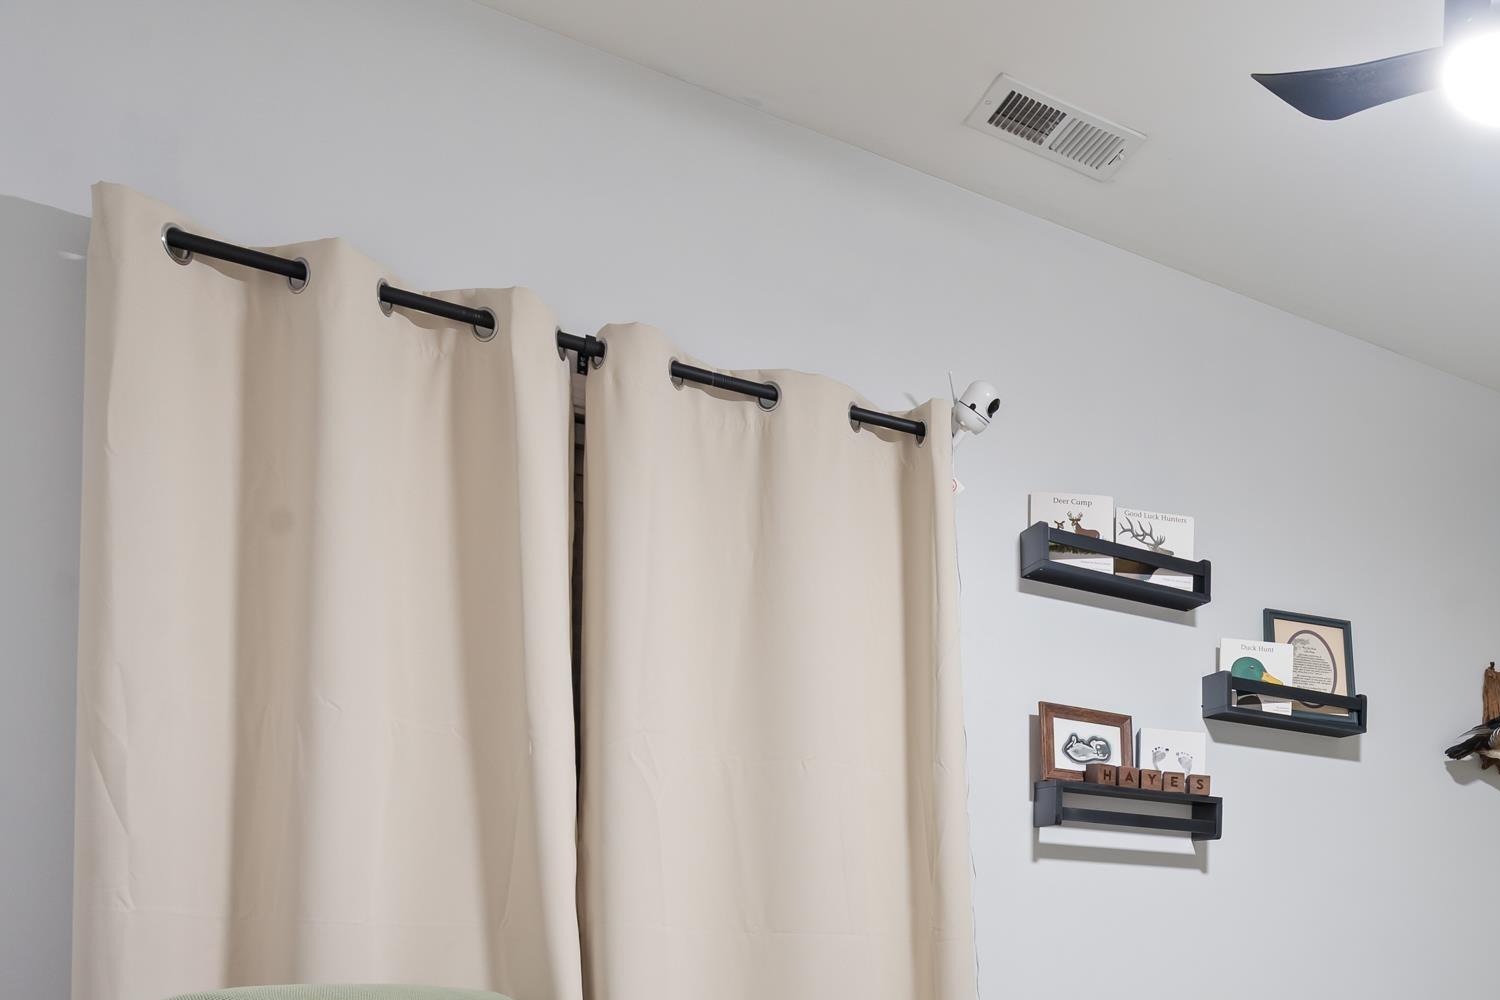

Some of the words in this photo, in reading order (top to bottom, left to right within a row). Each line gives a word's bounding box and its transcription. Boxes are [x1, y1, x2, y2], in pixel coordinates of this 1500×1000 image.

[1053, 497, 1069, 506] Deer
[1070, 498, 1093, 508] Camp
[1124, 509, 1142, 519] Good
[1143, 511, 1160, 521] Luck
[1160, 513, 1188, 524] Hunters
[1240, 643, 1257, 652] Duck
[1258, 645, 1274, 653] Hunt
[1103, 768, 1205, 790] HAYES
